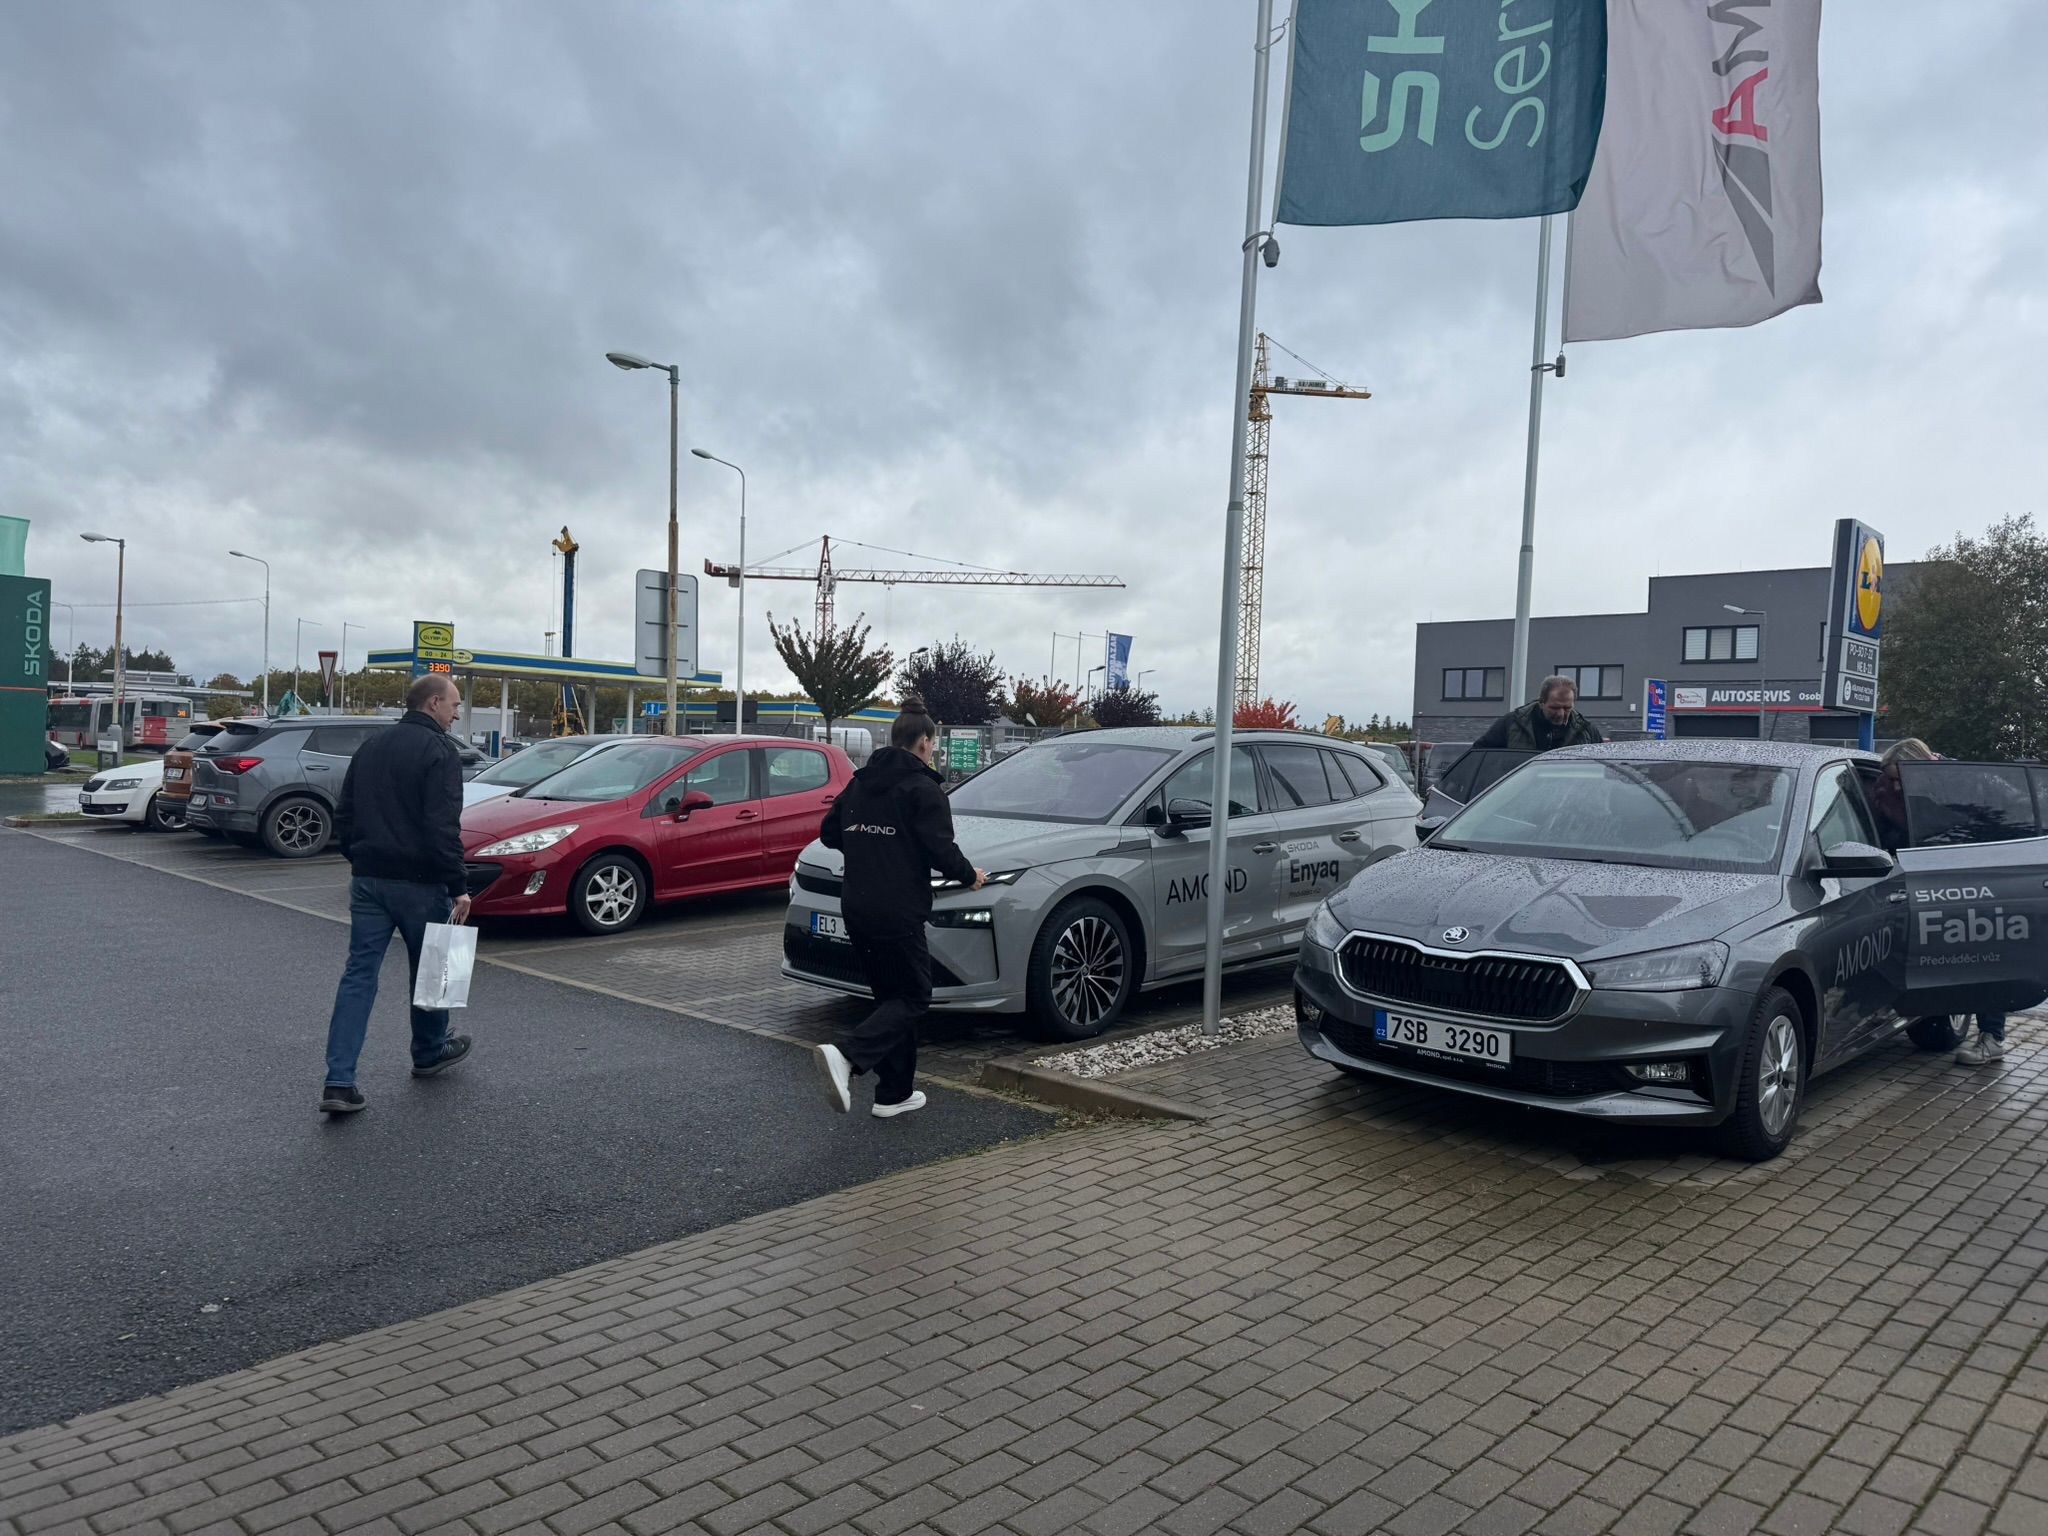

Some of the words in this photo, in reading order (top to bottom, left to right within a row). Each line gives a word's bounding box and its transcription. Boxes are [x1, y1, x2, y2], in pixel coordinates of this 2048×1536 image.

[1464, 0, 1554, 151] Ser
[1711, 689, 1791, 702] AUTOSERVIS
[1290, 859, 1339, 887] Enyaq
[819, 915, 837, 935] EL3
[1918, 907, 2029, 945] Fabia
[1834, 926, 1891, 988] AMOND
[1376, 1028, 1386, 1037] CZ
[1391, 1016, 1428, 1044] 7SB
[1445, 1027, 1499, 1057] 3290
